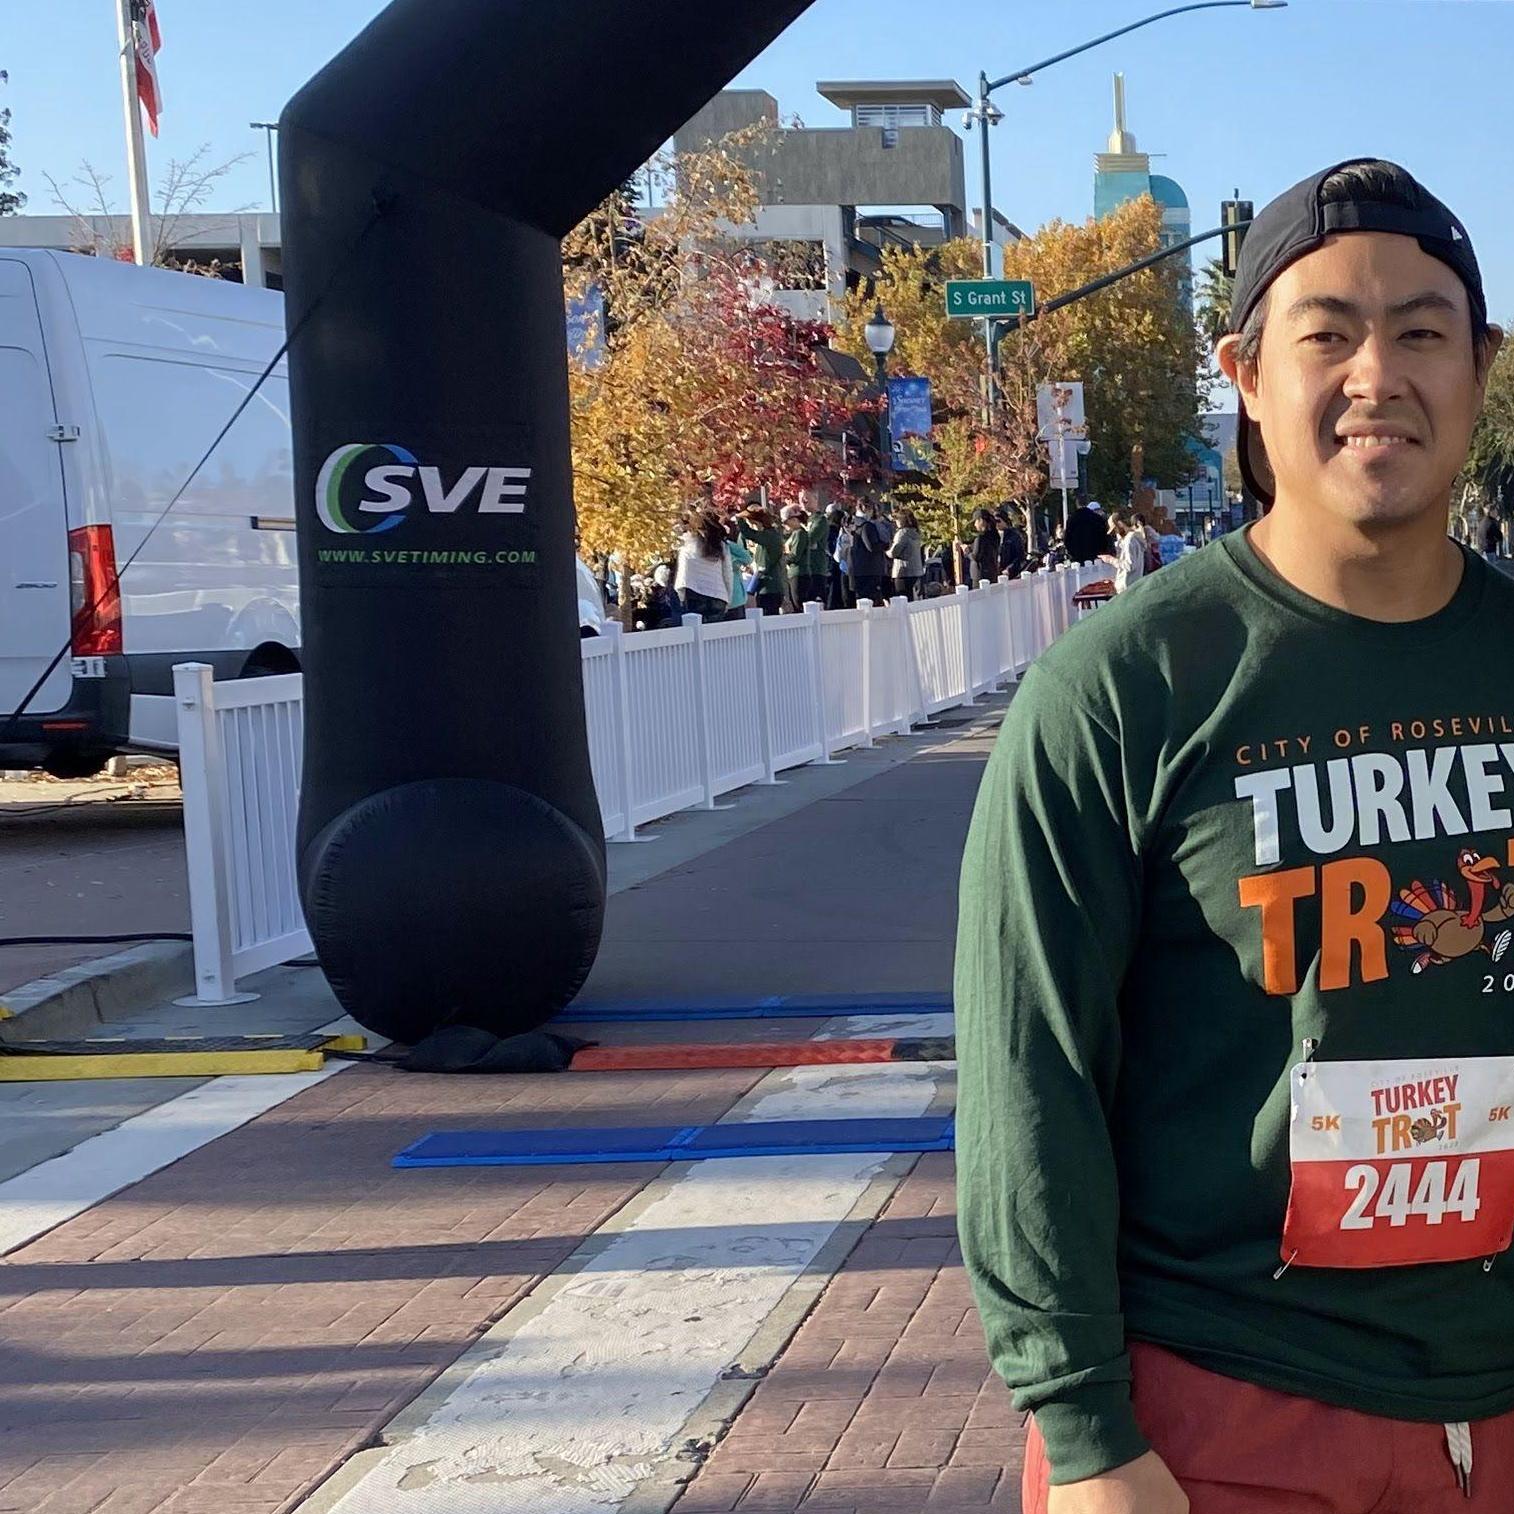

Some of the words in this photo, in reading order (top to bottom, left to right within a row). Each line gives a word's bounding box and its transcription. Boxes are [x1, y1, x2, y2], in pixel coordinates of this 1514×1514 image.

[953, 291, 962, 305] S
[968, 291, 1006, 305] Grant
[1011, 290, 1026, 305] St
[358, 465, 532, 513] SVE
[318, 549, 536, 564] WWW.SVETIMING.COM
[1236, 735, 1312, 765] CITY
[1334, 726, 1370, 748] OF
[1371, 1074, 1459, 1117] TURKEY
[1311, 1114, 1341, 1132] 5K
[1488, 1105, 1512, 1122] 5K
[1339, 1157, 1481, 1231] 2444
